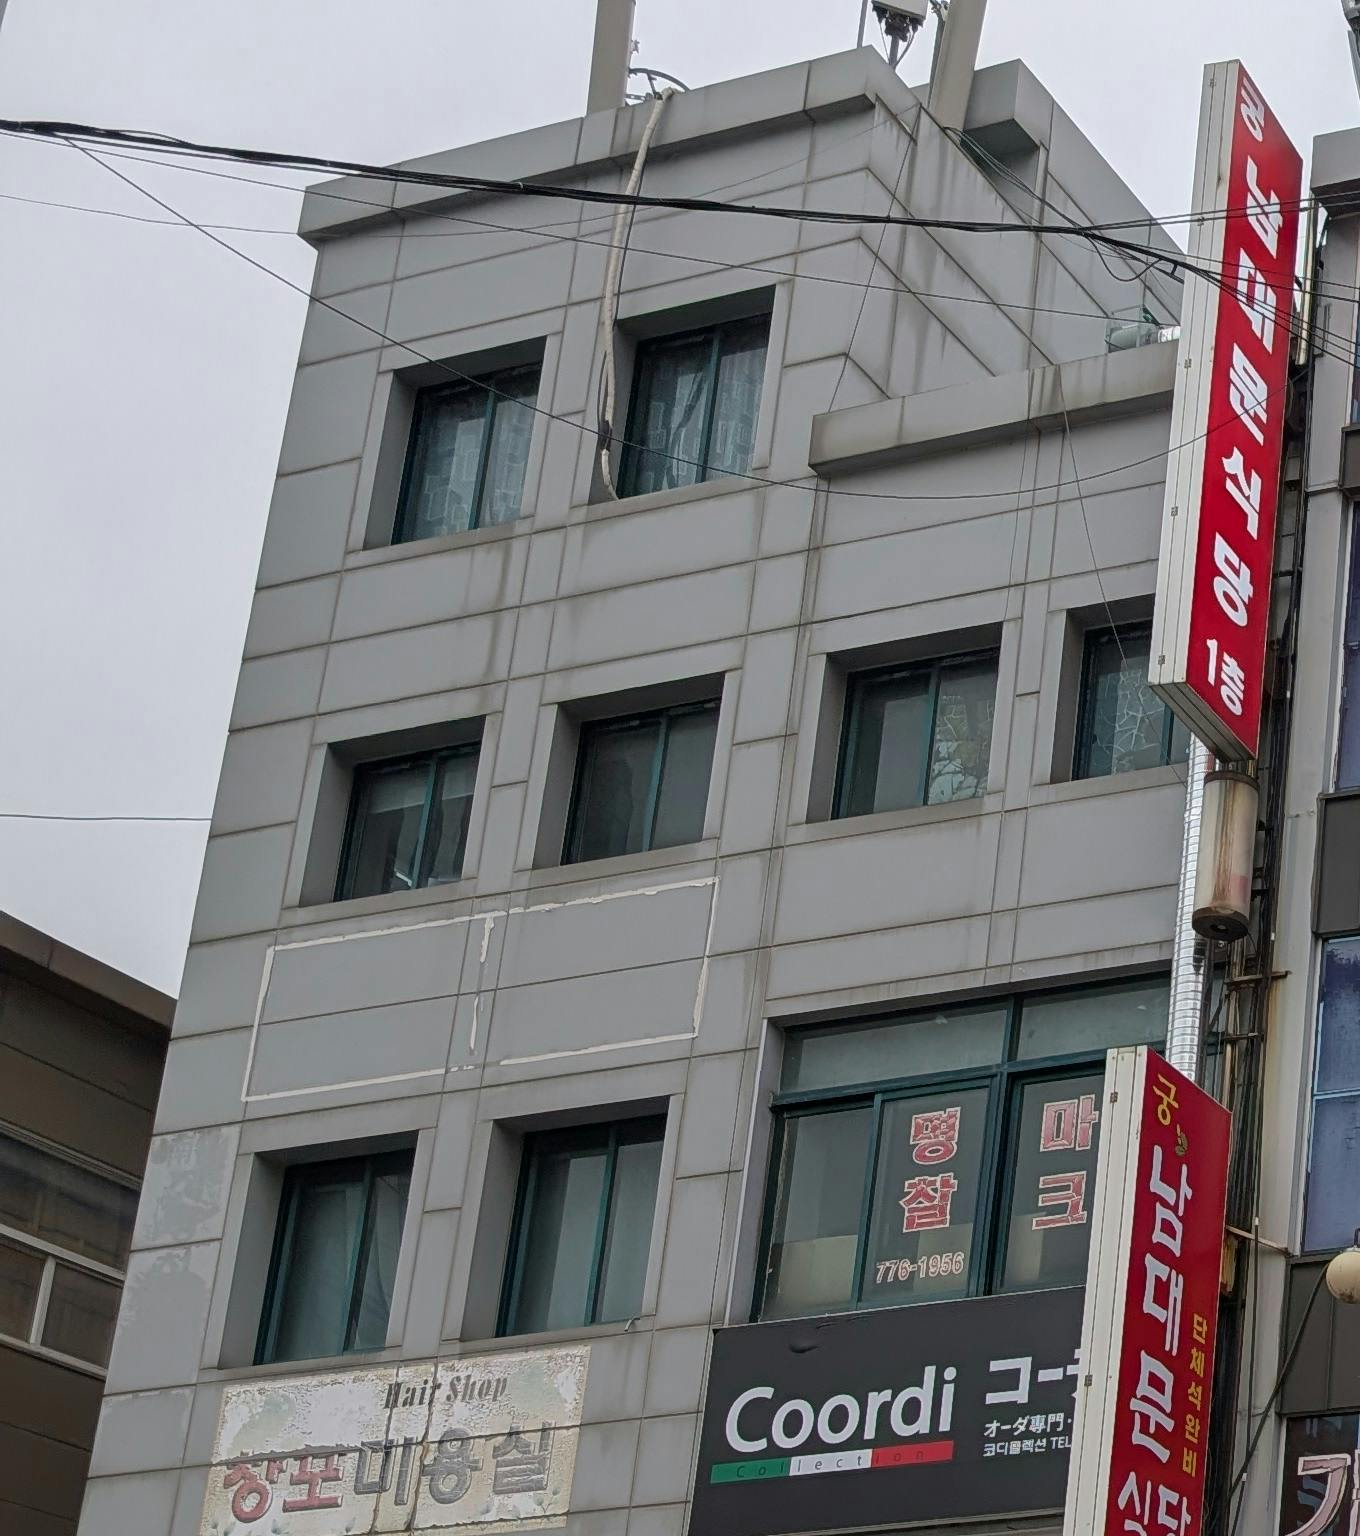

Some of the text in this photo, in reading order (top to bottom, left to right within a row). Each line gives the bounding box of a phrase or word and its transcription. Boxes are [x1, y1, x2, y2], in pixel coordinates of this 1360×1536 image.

[1214, 157, 1284, 628] 남대문식당
[1152, 1072, 1179, 1129] 궁
[899, 1107, 961, 1233] 명찰
[875, 1251, 965, 1284] 776-1956
[384, 1371, 509, 1410] Hair Shop
[725, 1365, 957, 1454] Coordi
[736, 1449, 925, 1478] Collection
[1050, 1435, 1072, 1451] TEL
